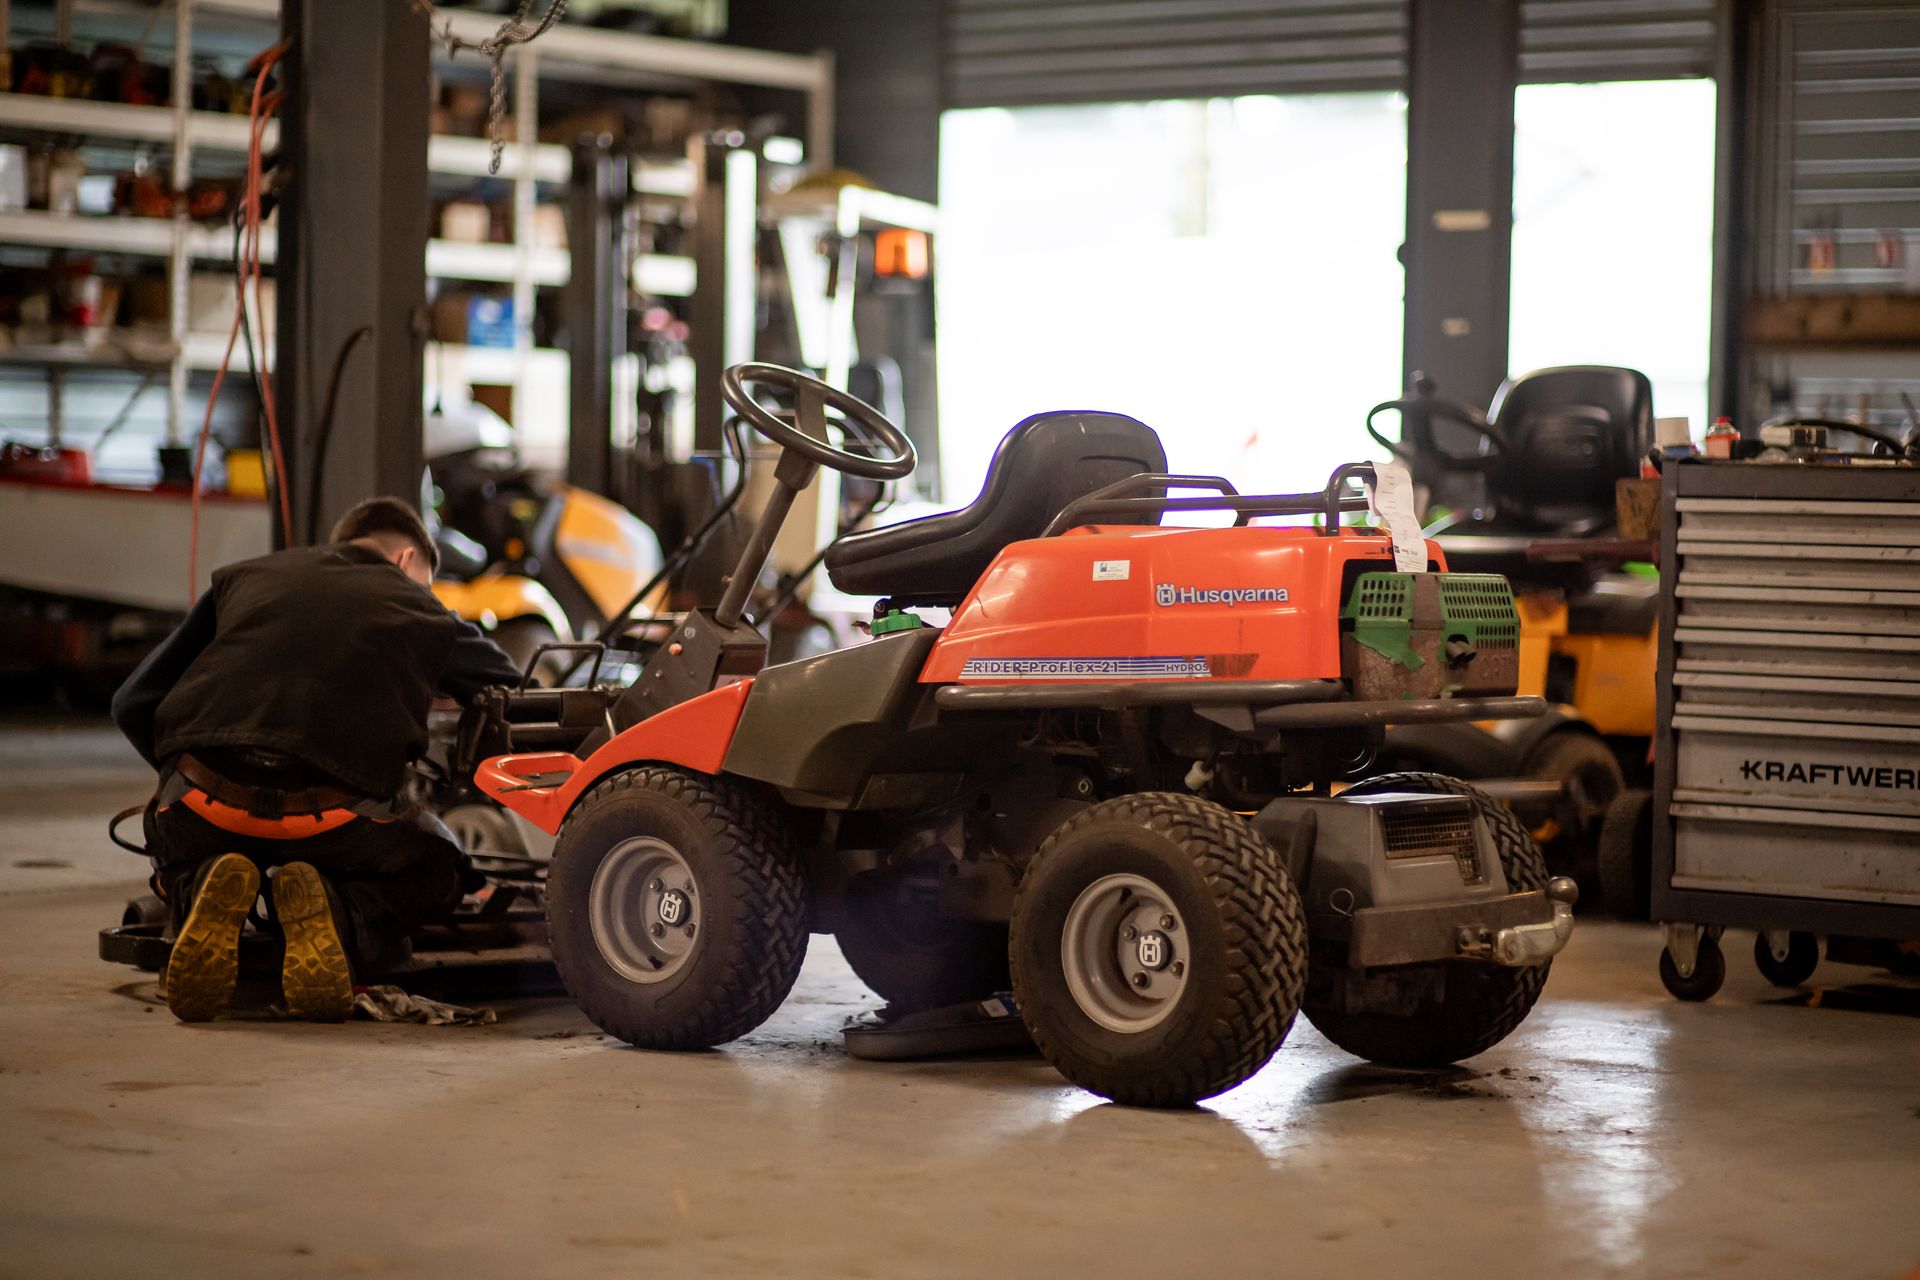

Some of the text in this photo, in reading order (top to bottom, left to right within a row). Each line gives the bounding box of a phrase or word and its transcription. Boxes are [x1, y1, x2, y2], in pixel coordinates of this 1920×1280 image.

[1180, 586, 1289, 607] Husqvarna
[973, 660, 1119, 673] RIDER ProFlex 21
[1739, 760, 1920, 790] KRAFTWER
